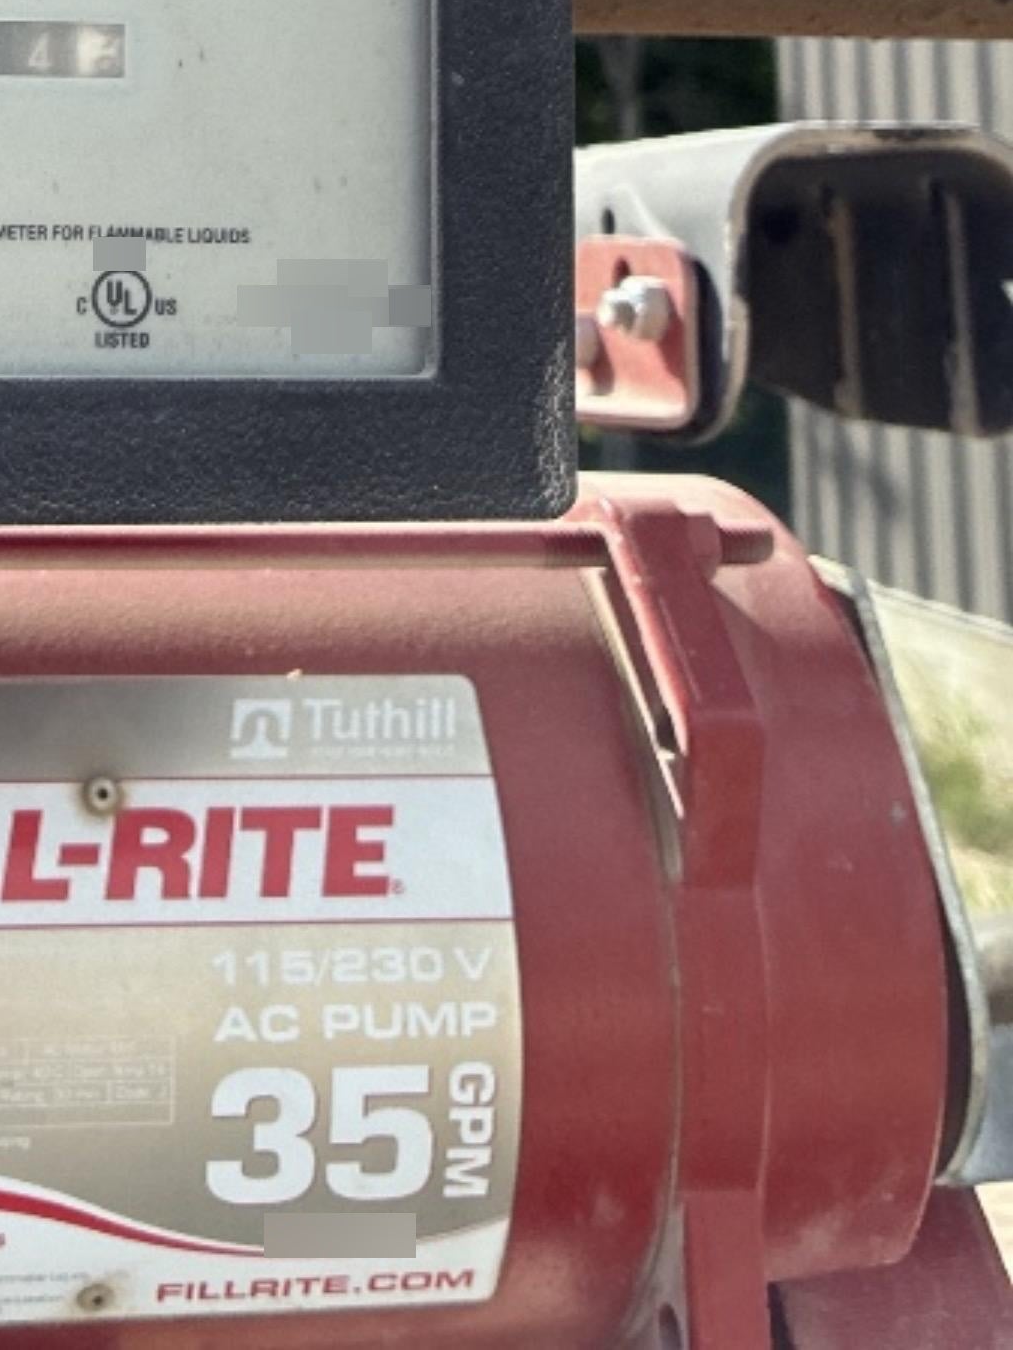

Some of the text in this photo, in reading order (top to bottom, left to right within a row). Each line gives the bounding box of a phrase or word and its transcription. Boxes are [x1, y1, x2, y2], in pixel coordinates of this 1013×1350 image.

[52, 225, 84, 242] FOR
[188, 227, 250, 244] LIQUIDS
[154, 299, 177, 316] US
[94, 332, 150, 349] LISTED
[302, 696, 456, 739] Tuthill
[211, 946, 443, 987] 115/230
[454, 946, 493, 980] V
[214, 1003, 300, 1043] AC
[322, 1001, 498, 1040] PUMP
[205, 1064, 434, 1204] 35
[442, 1061, 496, 1199] GPM
[156, 1270, 475, 1303] FILLRITE.COM
